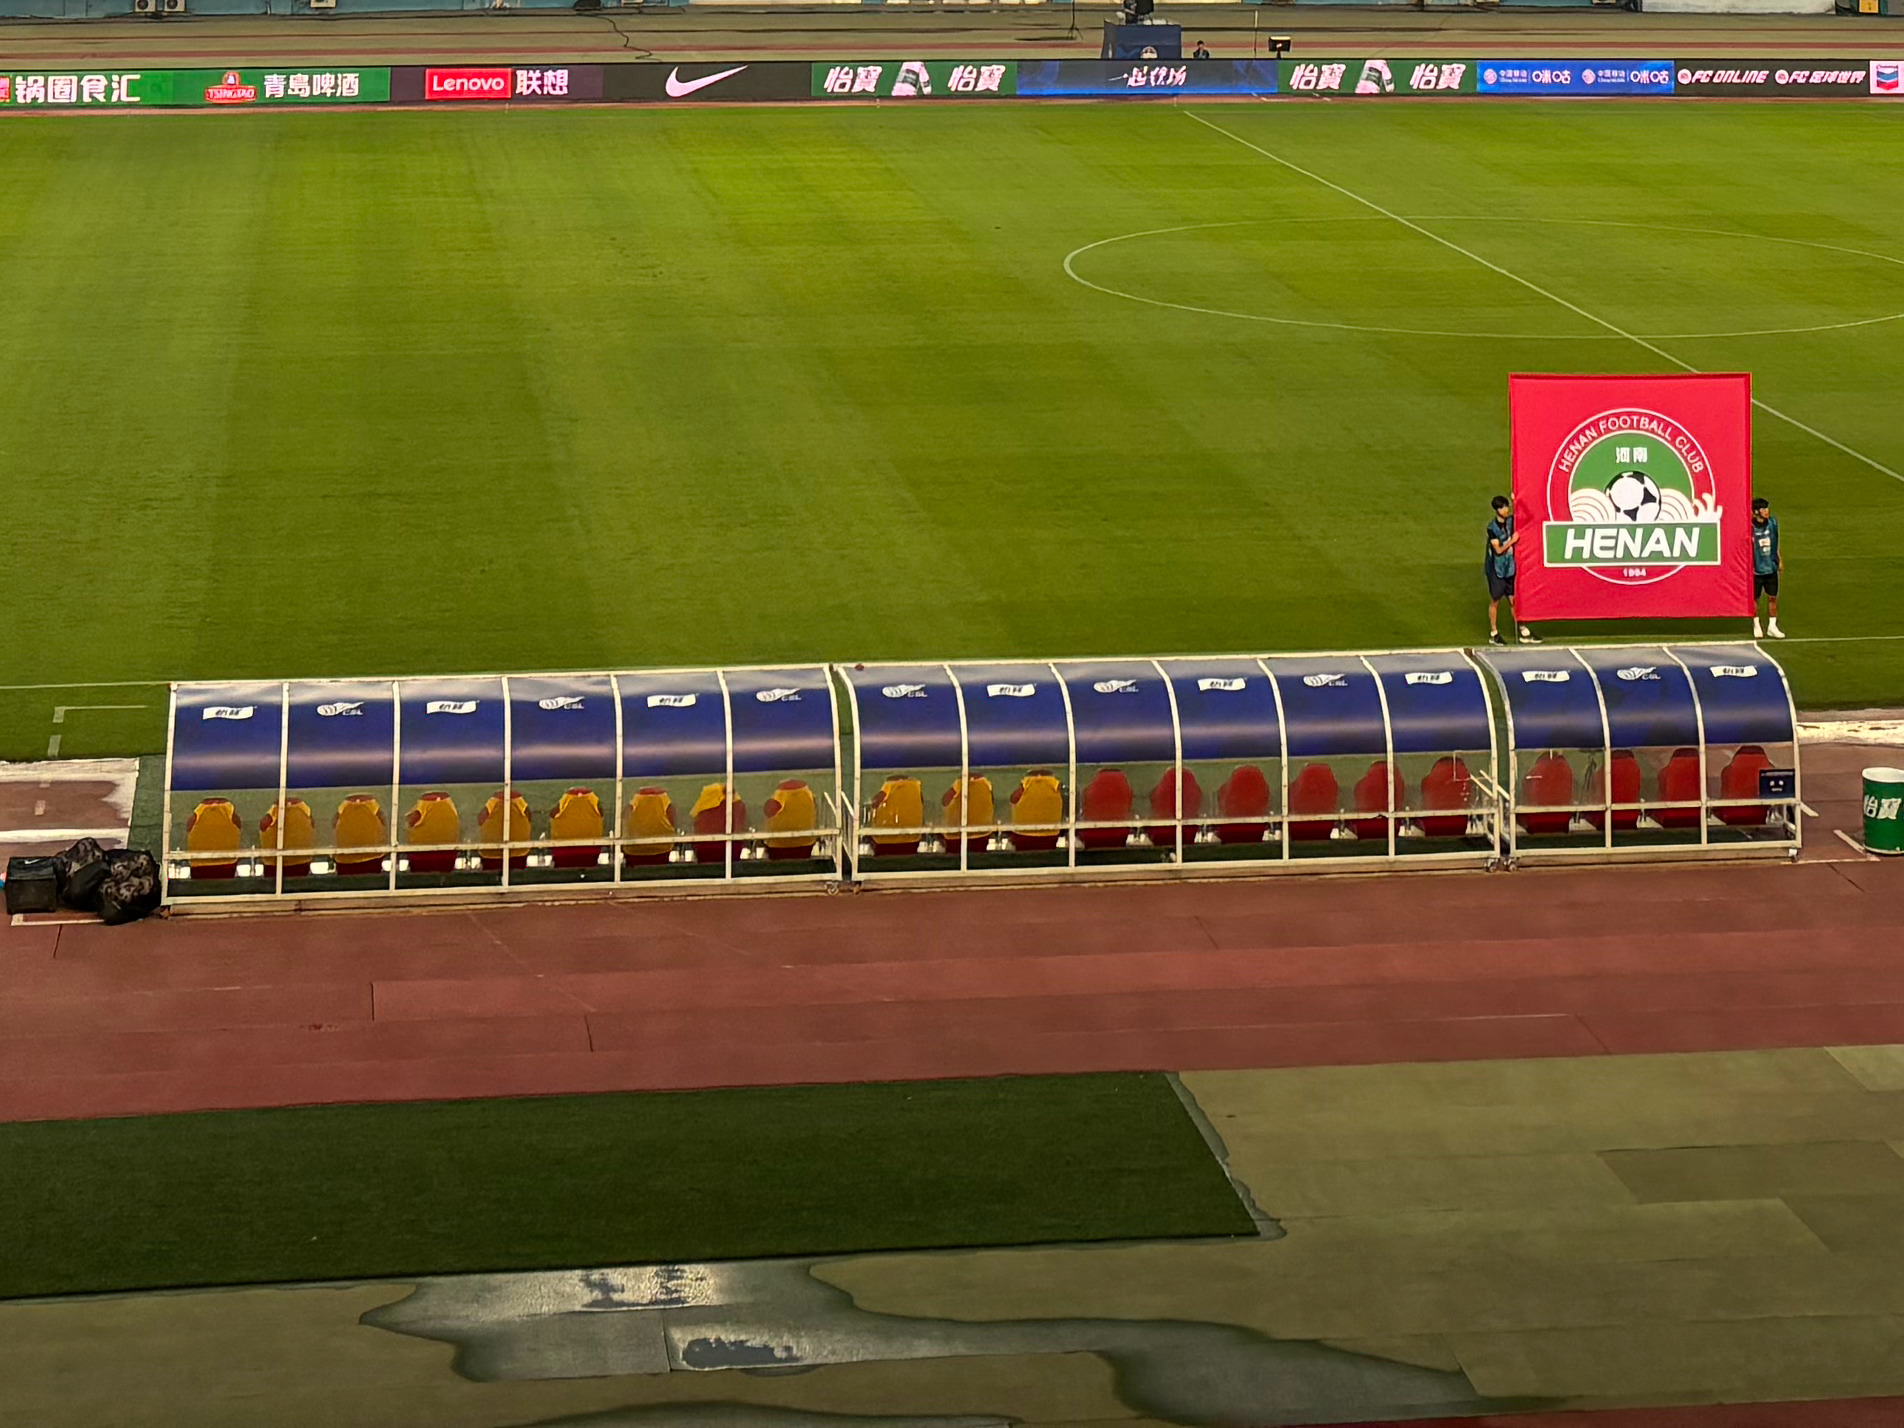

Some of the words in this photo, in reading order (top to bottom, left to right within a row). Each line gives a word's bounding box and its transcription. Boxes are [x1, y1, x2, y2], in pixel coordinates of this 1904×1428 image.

[15, 74, 141, 103] 锅圈食汇
[207, 87, 256, 101] TSINGTAO
[262, 72, 359, 97] 青岛啤酒
[432, 75, 505, 92] Lenovo
[515, 70, 569, 95] 联想
[824, 65, 882, 94] 怡寶
[948, 65, 1007, 93] 怡寶
[1290, 63, 1346, 91] 怡寶
[1409, 63, 1465, 91] 怡寶
[1691, 70, 1712, 84] FC
[1713, 70, 1767, 84] ONLINE
[1789, 70, 1808, 84] FC
[1559, 427, 1598, 473] HENAN
[1599, 415, 1672, 441] FOOTBALL
[1675, 434, 1705, 474] CLUB
[1564, 528, 1700, 560] HENAN
[1623, 568, 1646, 578] 1994
